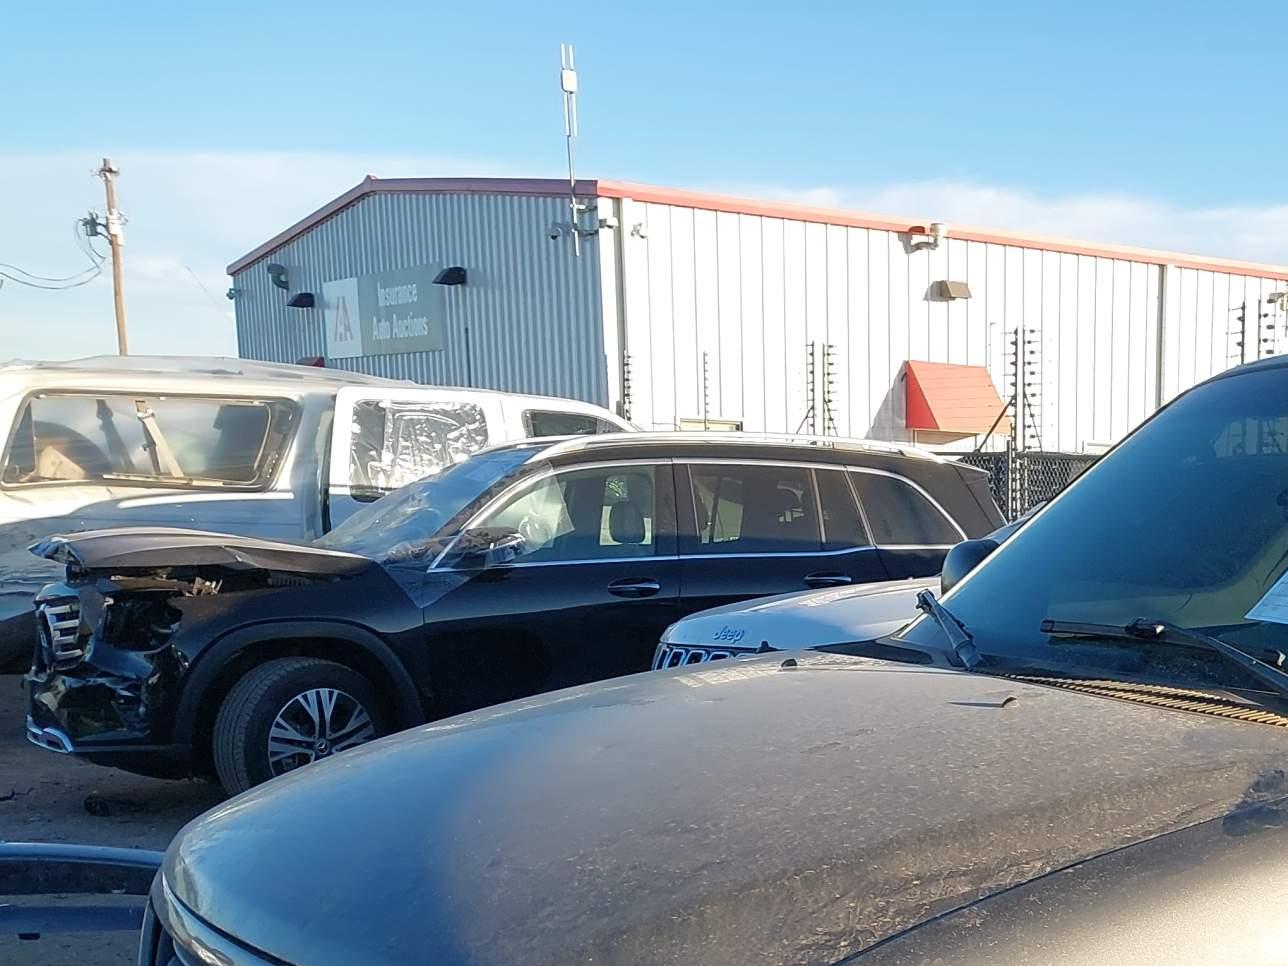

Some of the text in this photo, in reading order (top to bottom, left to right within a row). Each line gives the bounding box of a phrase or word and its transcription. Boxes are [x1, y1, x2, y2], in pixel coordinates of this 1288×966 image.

[377, 280, 418, 307] Insurance
[372, 311, 429, 341] Auto Auctions
[711, 625, 745, 645] Jeep
